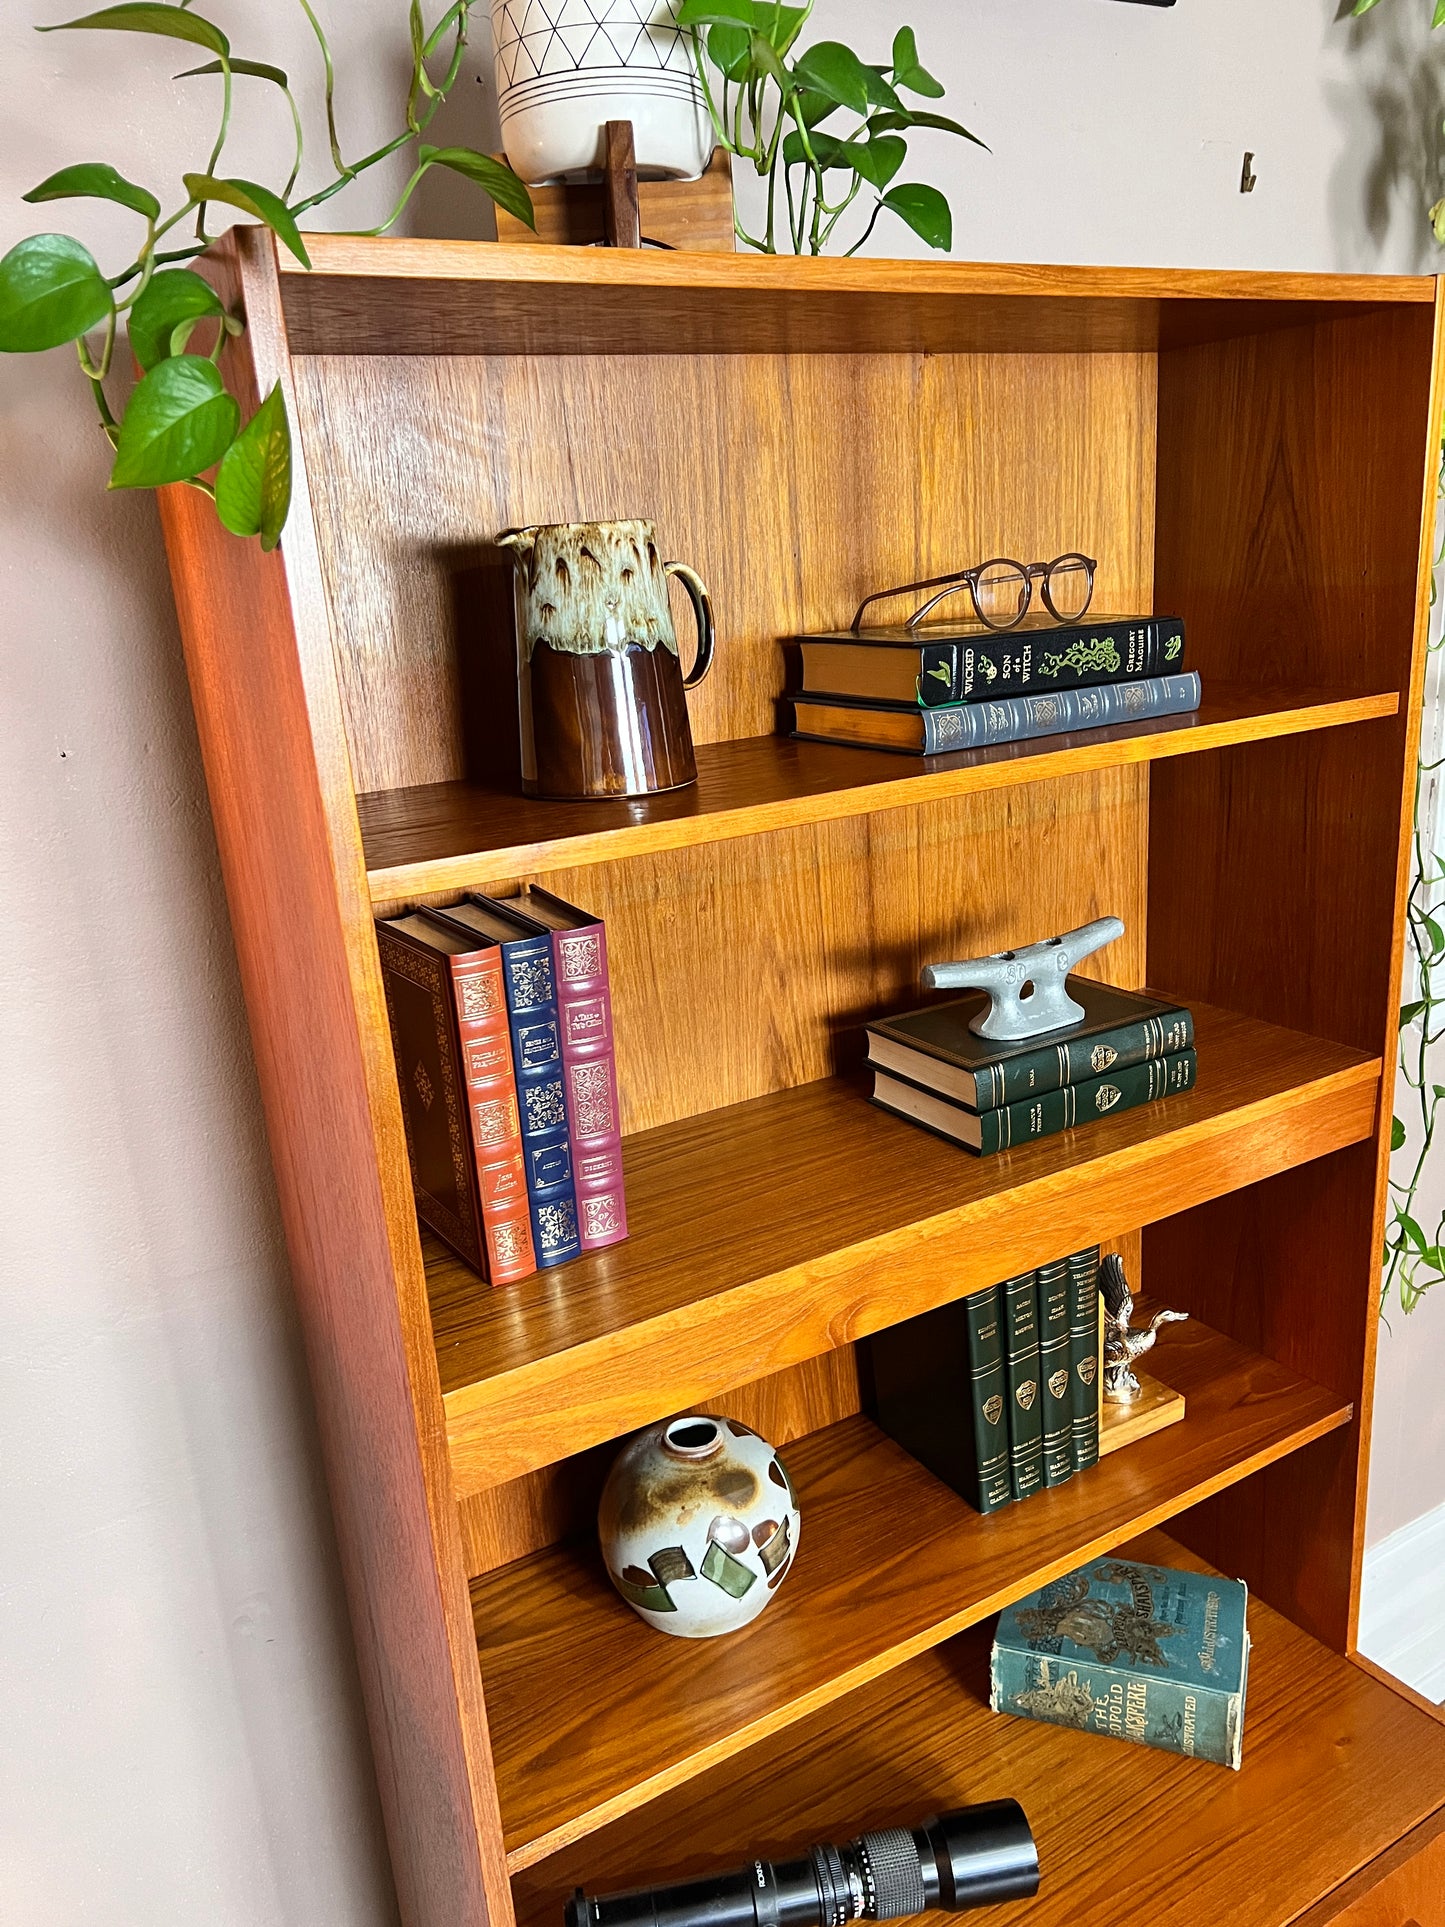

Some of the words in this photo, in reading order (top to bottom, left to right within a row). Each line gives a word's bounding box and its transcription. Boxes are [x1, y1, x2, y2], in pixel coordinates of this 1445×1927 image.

[1002, 655, 1011, 679] SON
[1012, 664, 1021, 673] of
[1022, 645, 1032, 684] WITCH
[1126, 630, 1136, 673] GREGORY
[1134, 628, 1144, 672] MAGUIRE
[964, 648, 975, 695] WICKED
[1095, 1694, 1110, 1729] THE
[1108, 1684, 1123, 1737] EOPOLD
